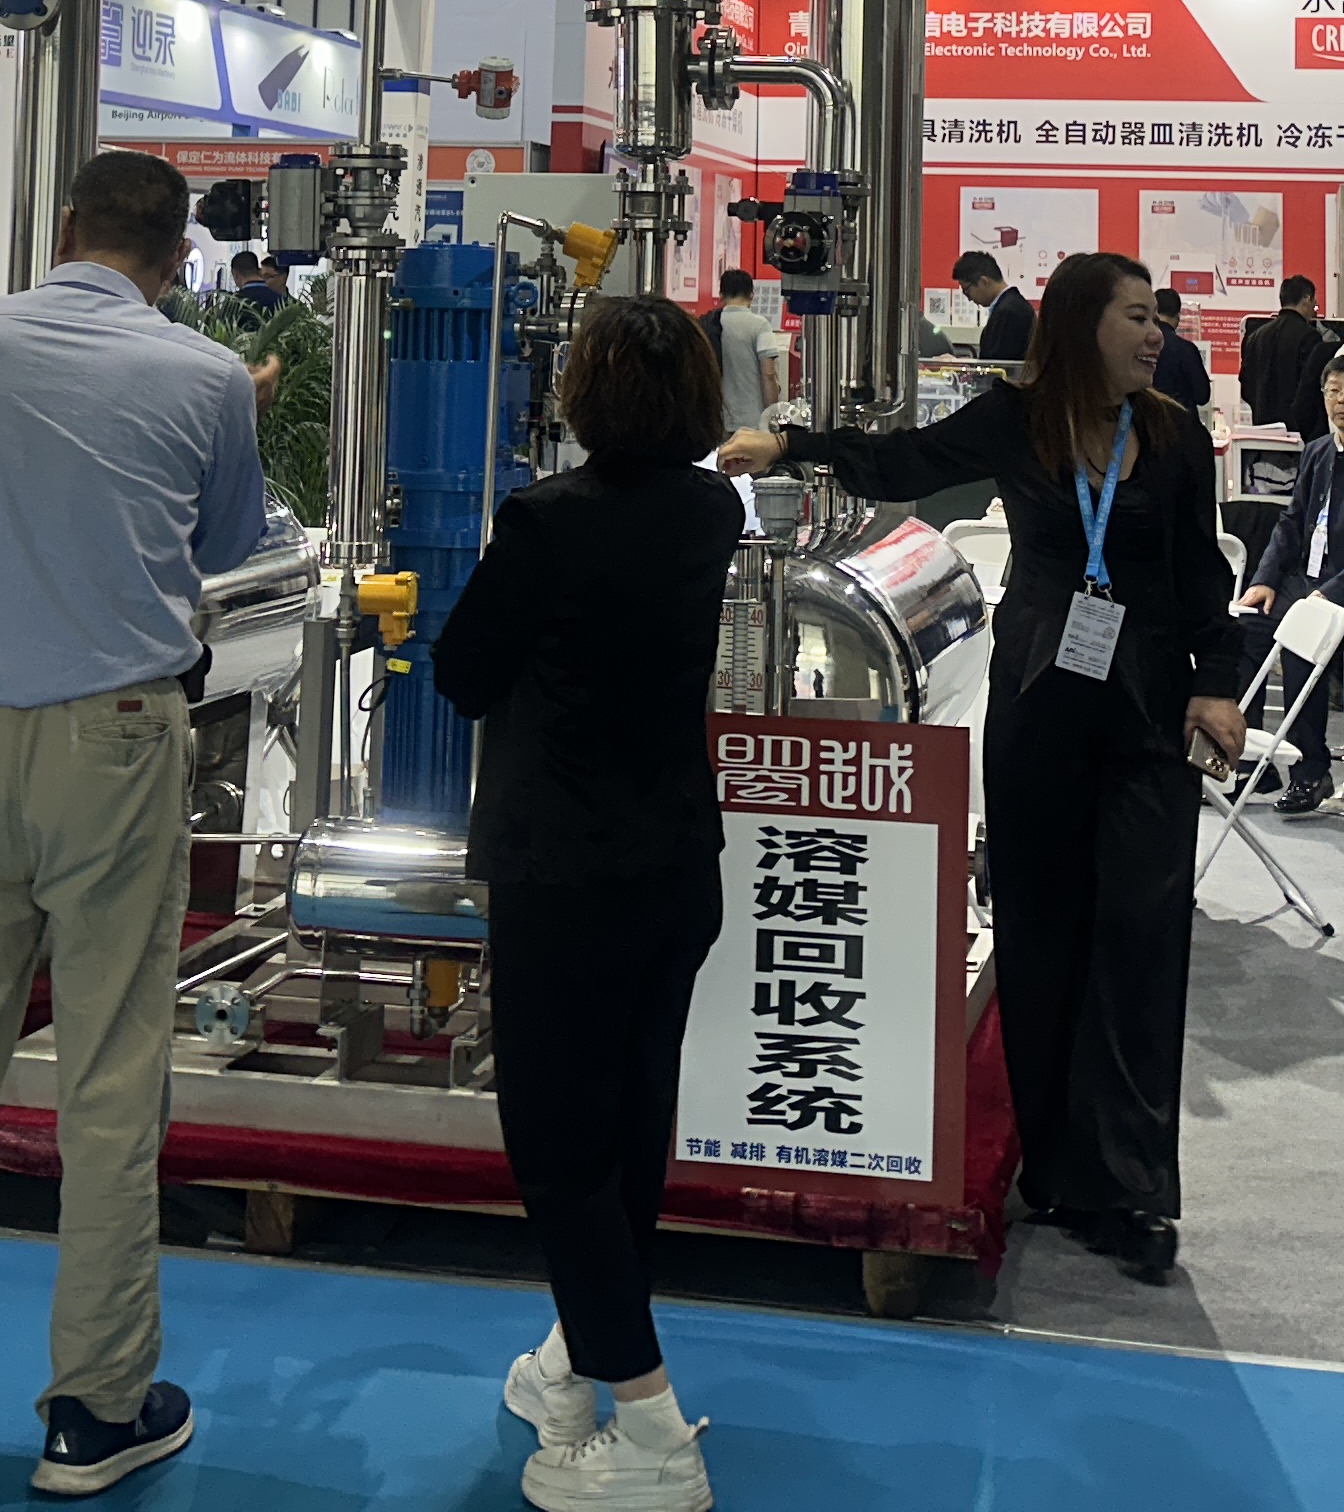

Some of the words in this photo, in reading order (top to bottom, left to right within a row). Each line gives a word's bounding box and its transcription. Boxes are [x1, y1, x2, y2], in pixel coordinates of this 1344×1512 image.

[924, 42, 995, 58] Electronic
[999, 43, 1085, 61] Technology
[1122, 43, 1152, 59] Ltd.
[111, 109, 144, 122] Beijing
[1034, 119, 1263, 149] 全自动器皿清洗机
[750, 609, 763, 624] 40
[717, 670, 730, 686] 30
[749, 672, 763, 688] 30
[746, 825, 870, 1135] 溶媒回收系统
[685, 1137, 721, 1158] 节能
[730, 1141, 766, 1162] 减排
[775, 1145, 923, 1176] 有机溶媒二次回收
